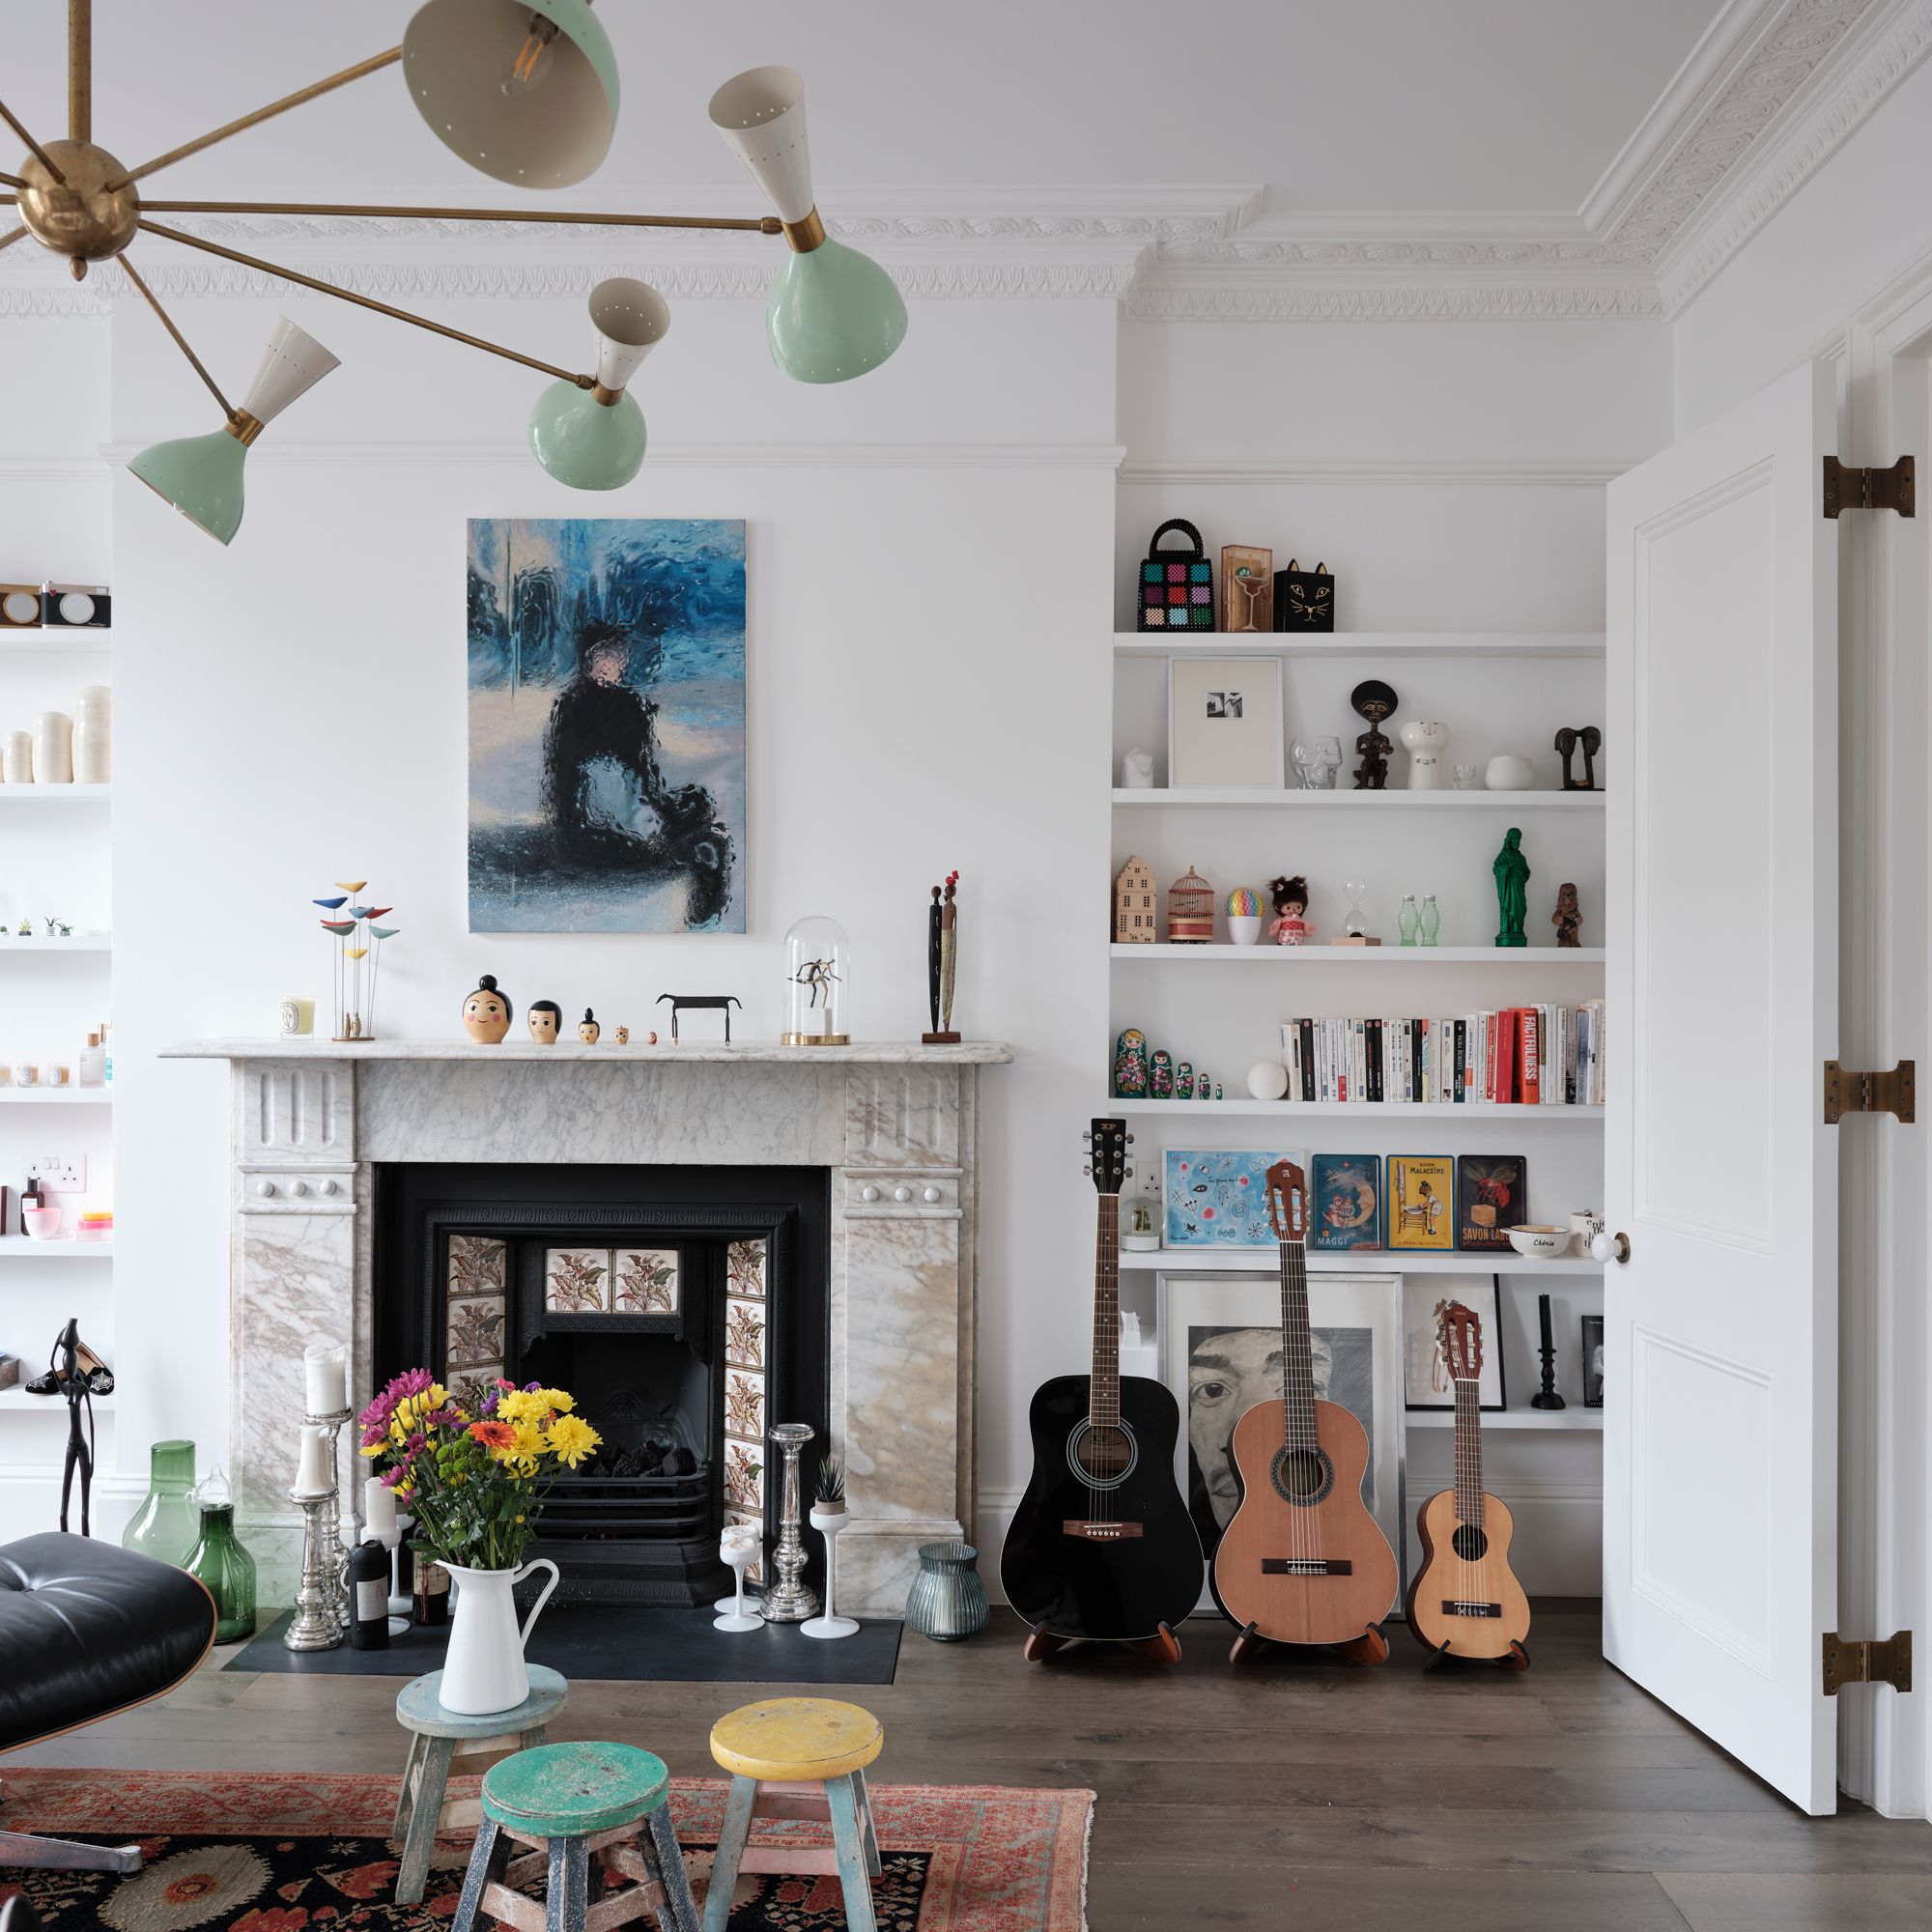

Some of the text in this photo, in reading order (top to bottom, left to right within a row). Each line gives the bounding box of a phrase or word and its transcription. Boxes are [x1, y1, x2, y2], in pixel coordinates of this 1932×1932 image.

[1524, 1016, 1537, 1080] FACTFULNESS
[1463, 1227, 1489, 1240] SAVON
[1318, 1236, 1347, 1246] MAGGI
